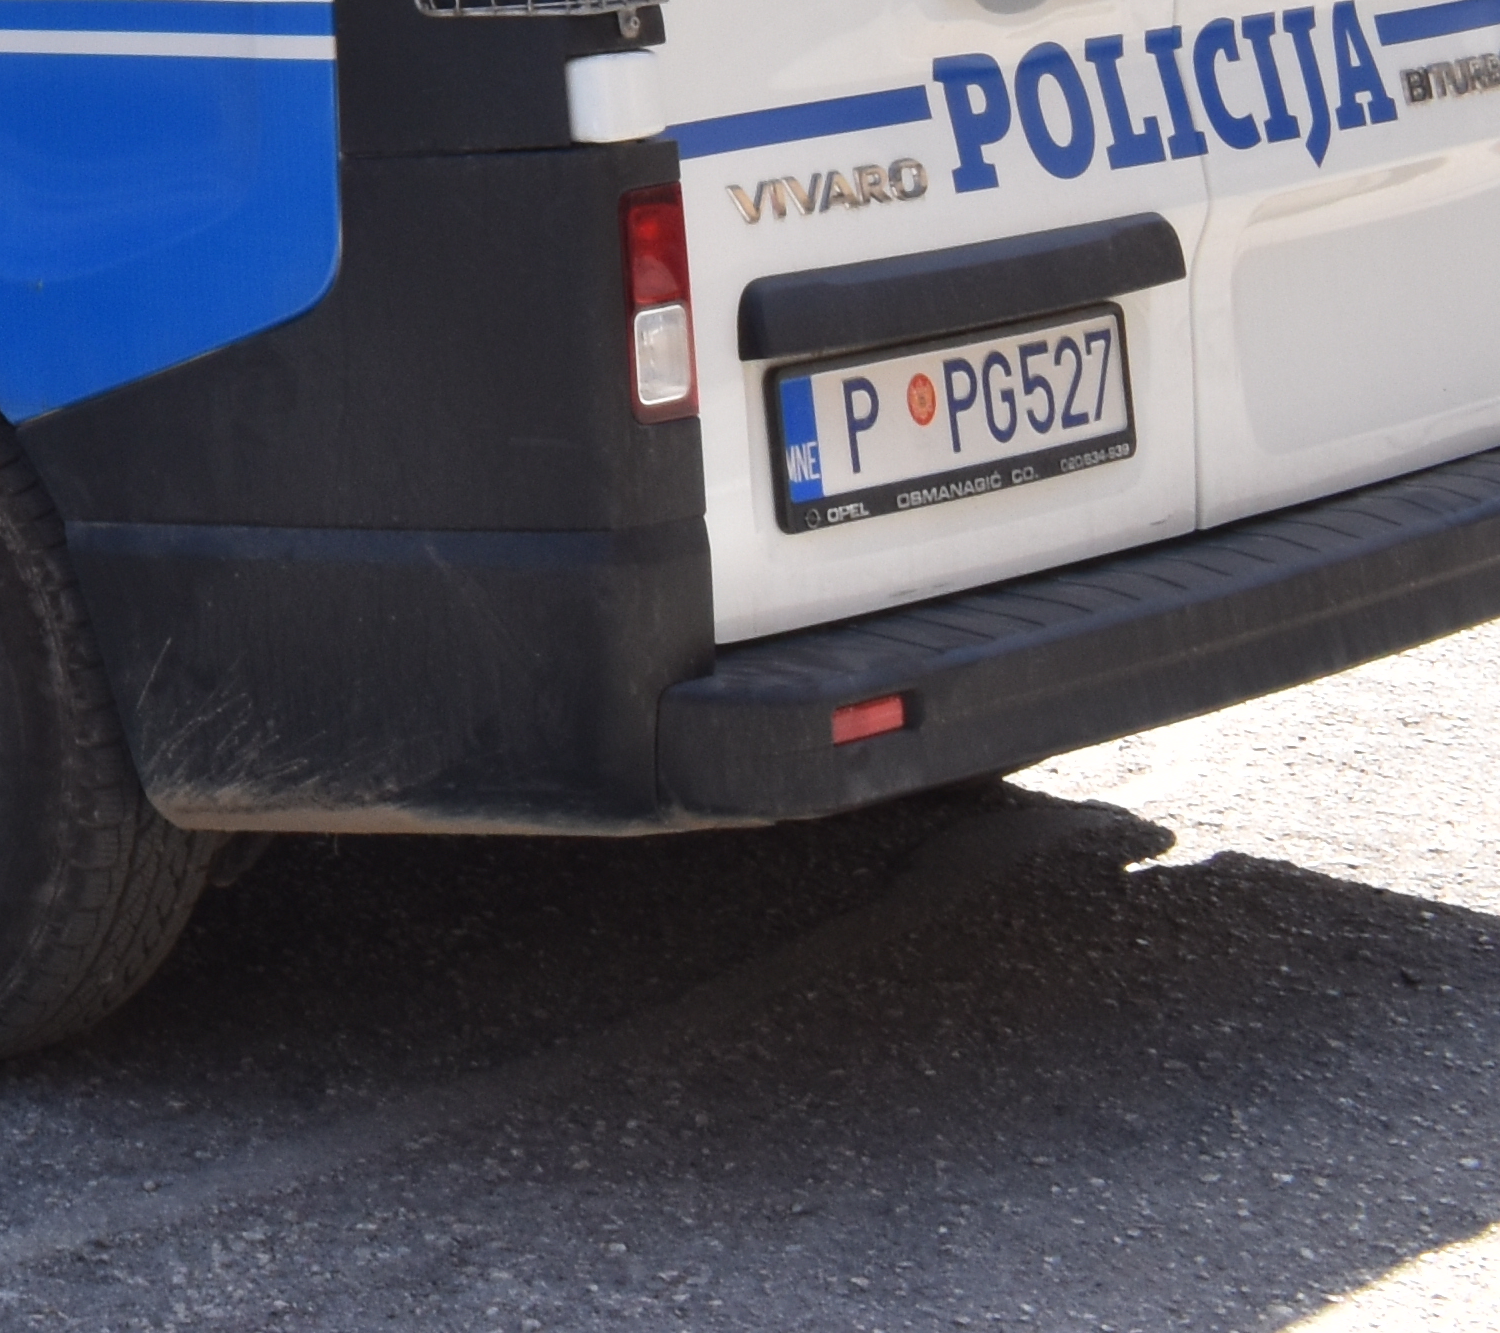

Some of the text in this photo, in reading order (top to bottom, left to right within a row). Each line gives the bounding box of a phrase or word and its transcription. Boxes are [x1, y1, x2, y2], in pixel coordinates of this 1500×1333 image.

[931, 0, 1398, 194] POLICIJA
[725, 156, 929, 225] VIVARO
[842, 328, 1113, 475] P PG527
[826, 501, 870, 523] OPEL
